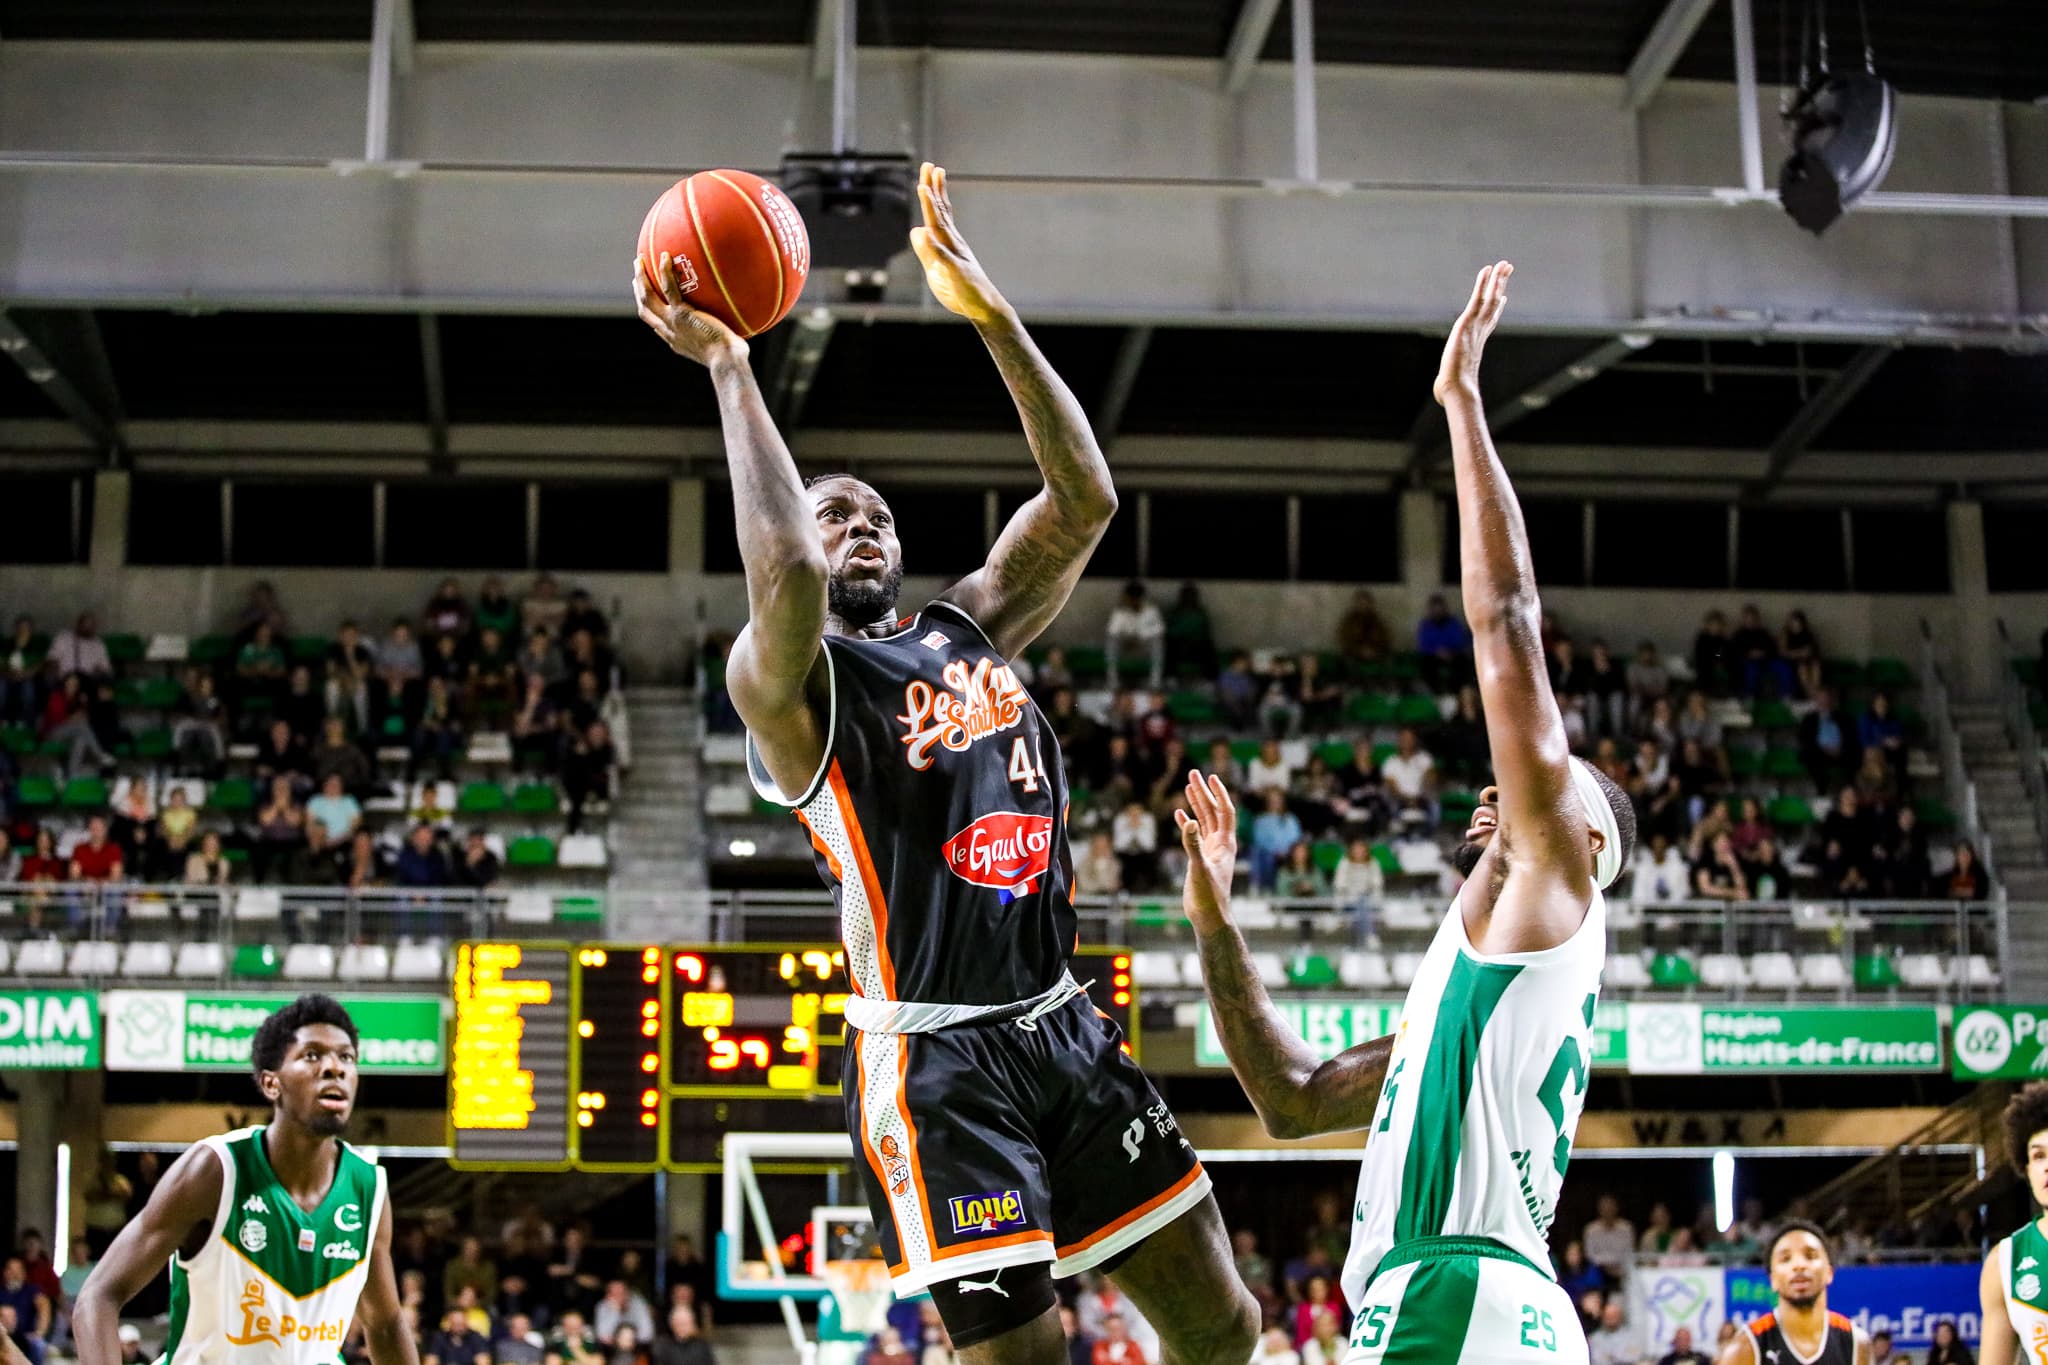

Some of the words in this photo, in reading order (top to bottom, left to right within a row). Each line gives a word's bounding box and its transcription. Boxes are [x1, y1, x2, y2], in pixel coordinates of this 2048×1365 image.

[897, 680, 955, 772] Le
[941, 686, 1022, 752] Sarthe
[951, 842, 967, 865] le
[969, 823, 1051, 876] Gauloi
[1703, 1012, 1783, 1040] Région
[1965, 1025, 2001, 1055] 62
[1704, 1037, 1936, 1064] Hauts-de-France
[953, 1189, 1021, 1228] Loué
[280, 1314, 344, 1343] Portel
[1351, 1304, 1393, 1349] 25
[1520, 1303, 1557, 1353] 25
